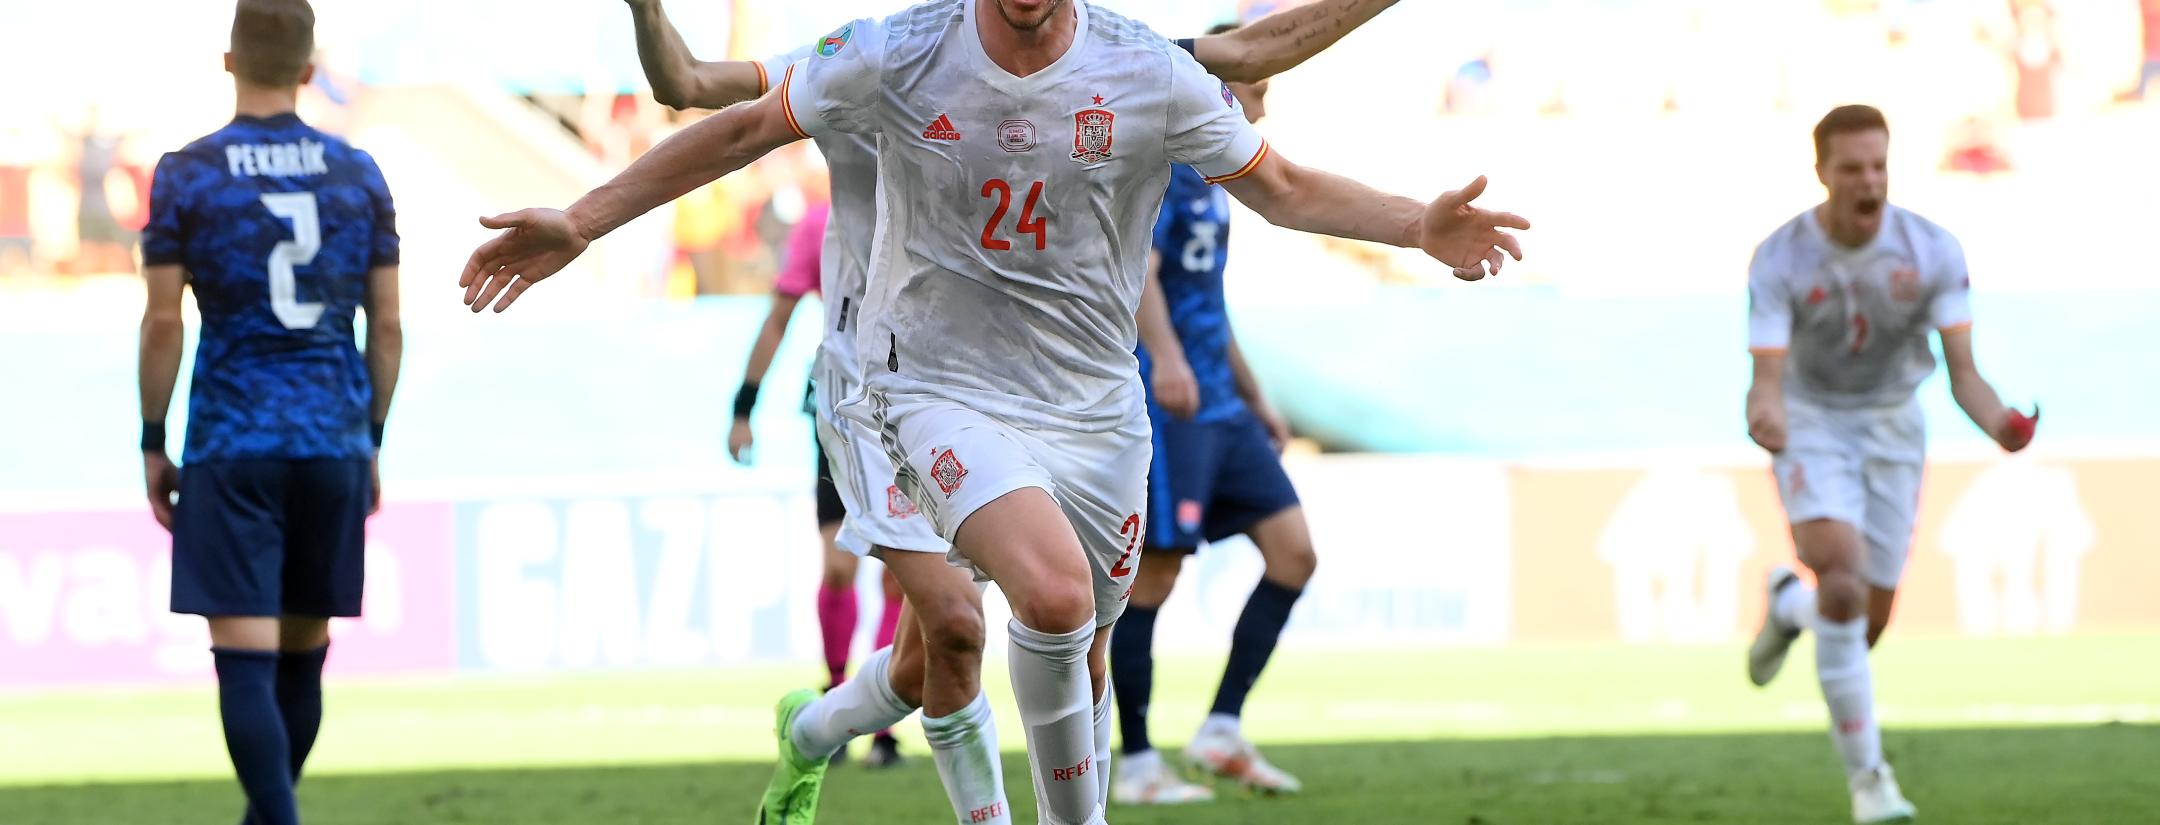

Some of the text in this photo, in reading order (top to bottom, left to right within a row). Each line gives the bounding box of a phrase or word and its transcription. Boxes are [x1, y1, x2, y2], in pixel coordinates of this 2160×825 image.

[922, 129, 961, 141] adidas
[981, 178, 1047, 251] 24
[259, 190, 327, 330] 2
[1052, 755, 1091, 781] RFEF
